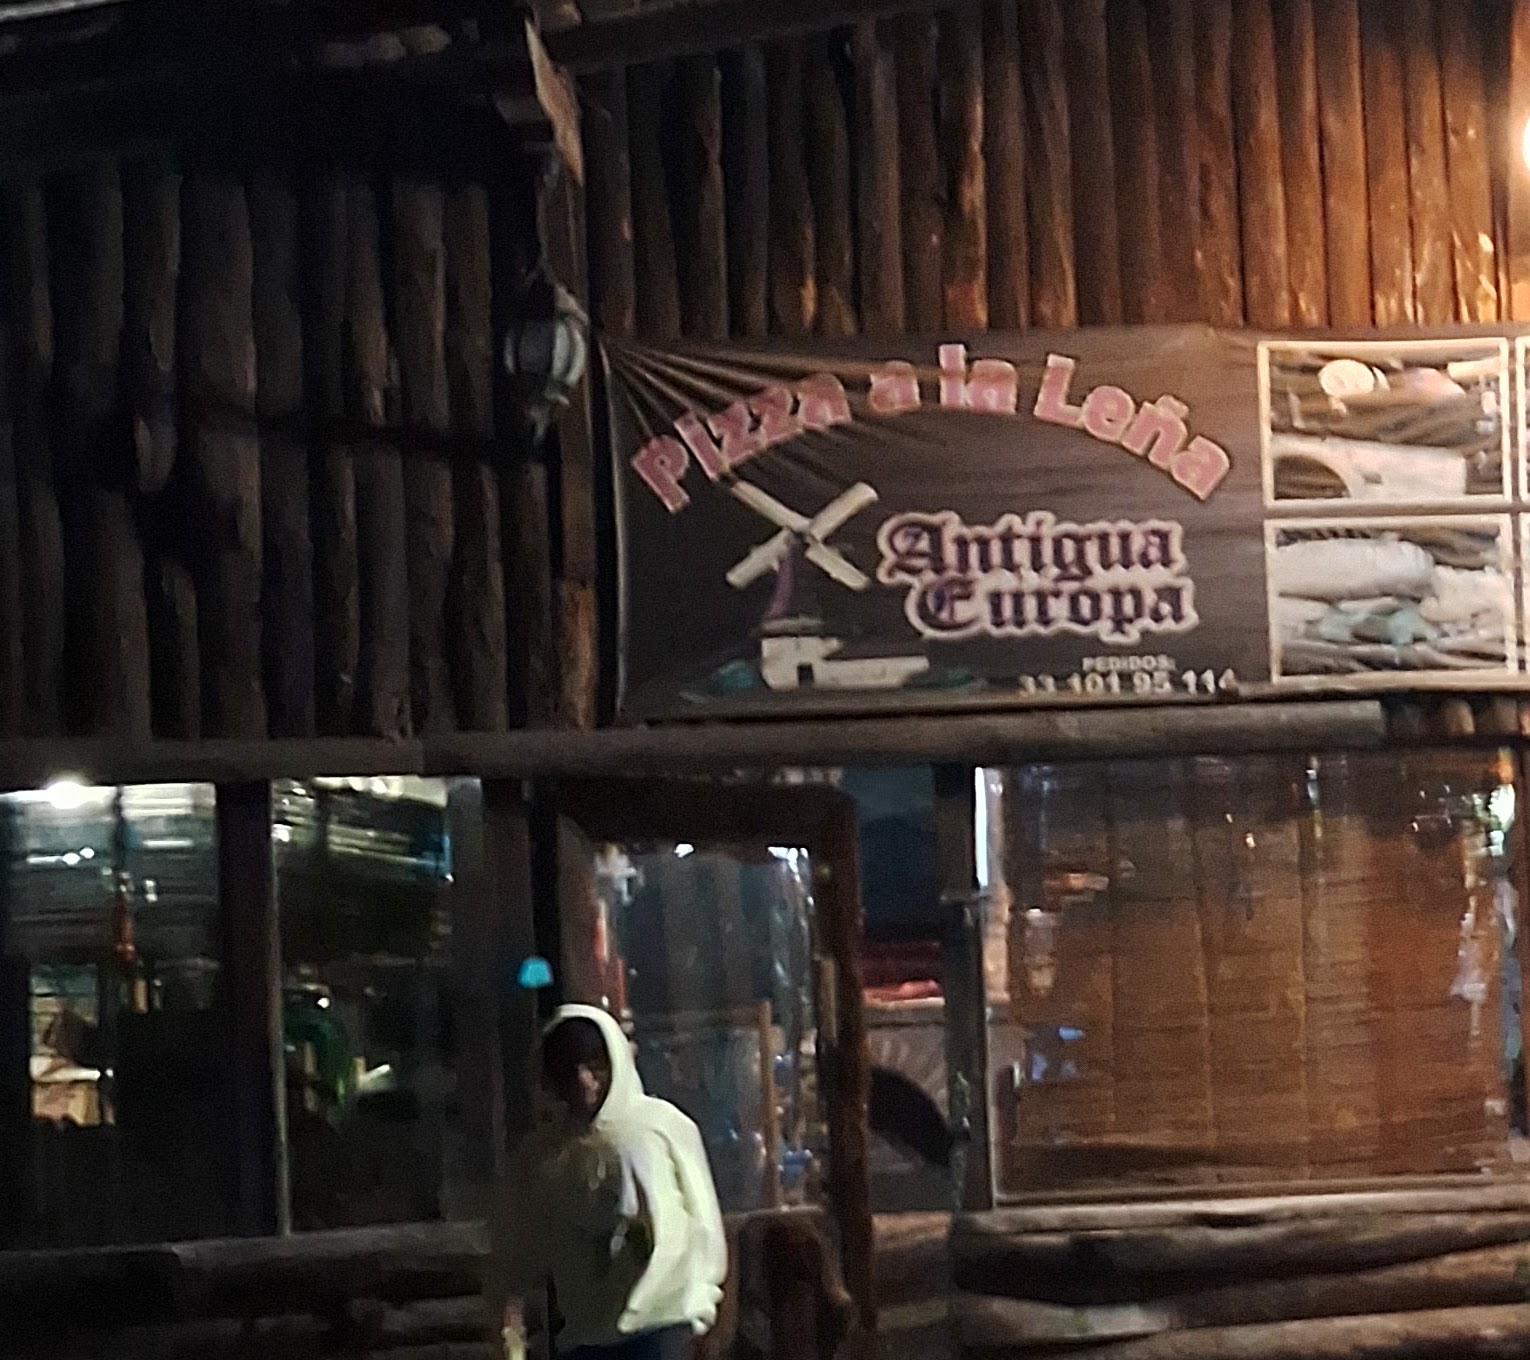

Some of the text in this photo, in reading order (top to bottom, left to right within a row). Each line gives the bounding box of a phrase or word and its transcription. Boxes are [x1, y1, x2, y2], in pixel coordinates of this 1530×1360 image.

[868, 358, 922, 417] a
[938, 342, 1019, 416] la
[1033, 353, 1232, 502] Leña
[880, 512, 1187, 584] Antigua
[908, 580, 1196, 642] Europa
